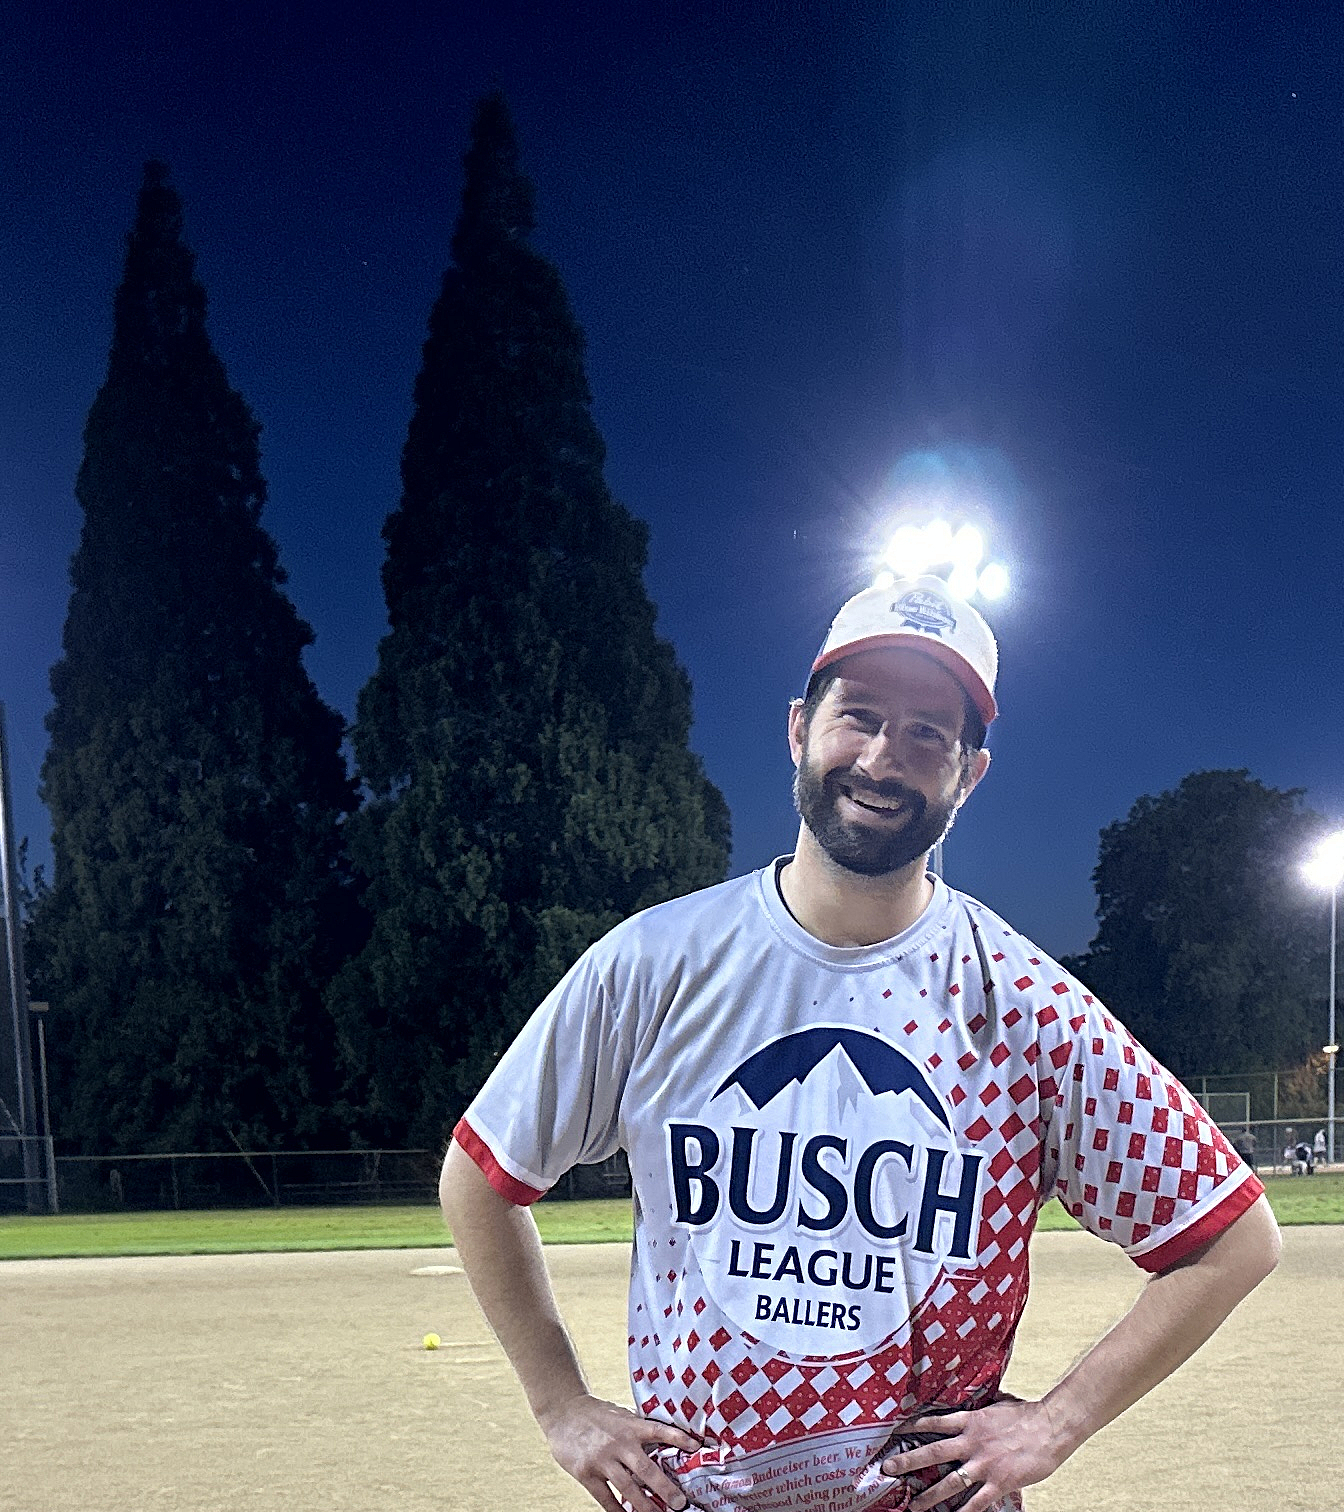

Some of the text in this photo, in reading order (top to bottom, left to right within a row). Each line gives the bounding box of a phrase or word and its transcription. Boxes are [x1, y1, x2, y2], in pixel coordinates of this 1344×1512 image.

[668, 1123, 984, 1259] BUSCH
[727, 1240, 896, 1294] LEAGUE
[755, 1295, 861, 1331] BALLERS
[752, 1461, 810, 1484] Budweiser
[813, 1453, 841, 1467] beer.
[844, 1446, 862, 1459] We
[775, 1473, 813, 1494] which
[815, 1467, 847, 1483] costs
[795, 1489, 830, 1505] Aging
[828, 1497, 853, 1512] find
